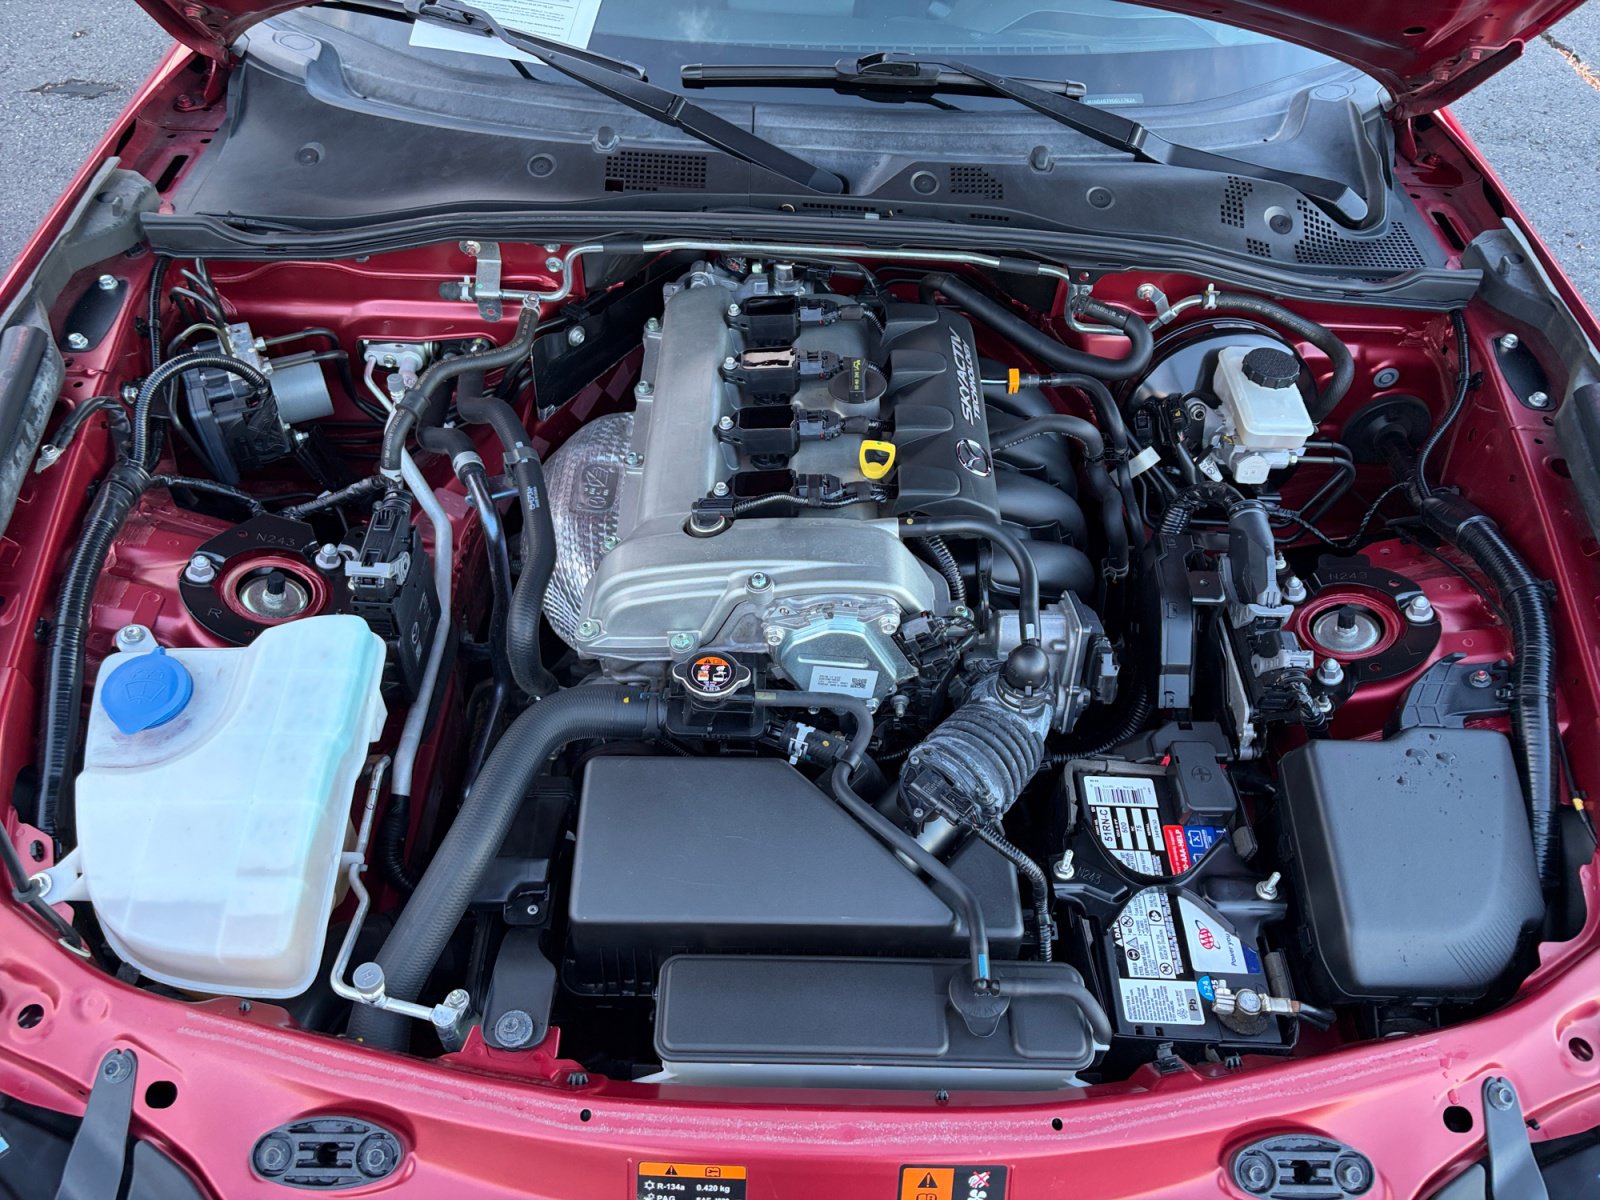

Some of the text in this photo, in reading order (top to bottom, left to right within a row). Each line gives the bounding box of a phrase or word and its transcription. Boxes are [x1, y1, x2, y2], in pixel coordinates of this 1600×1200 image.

[949, 326, 974, 426] SKYACTIV
[963, 340, 981, 420] TECHNOLOGY
[256, 533, 296, 547] N243
[207, 607, 223, 620] R
[1099, 809, 1114, 842] 51RN-C
[1199, 928, 1214, 950] AAA
[1188, 998, 1198, 1012] Pb
[656, 1182, 731, 1194] R-134a 0.420 kg
